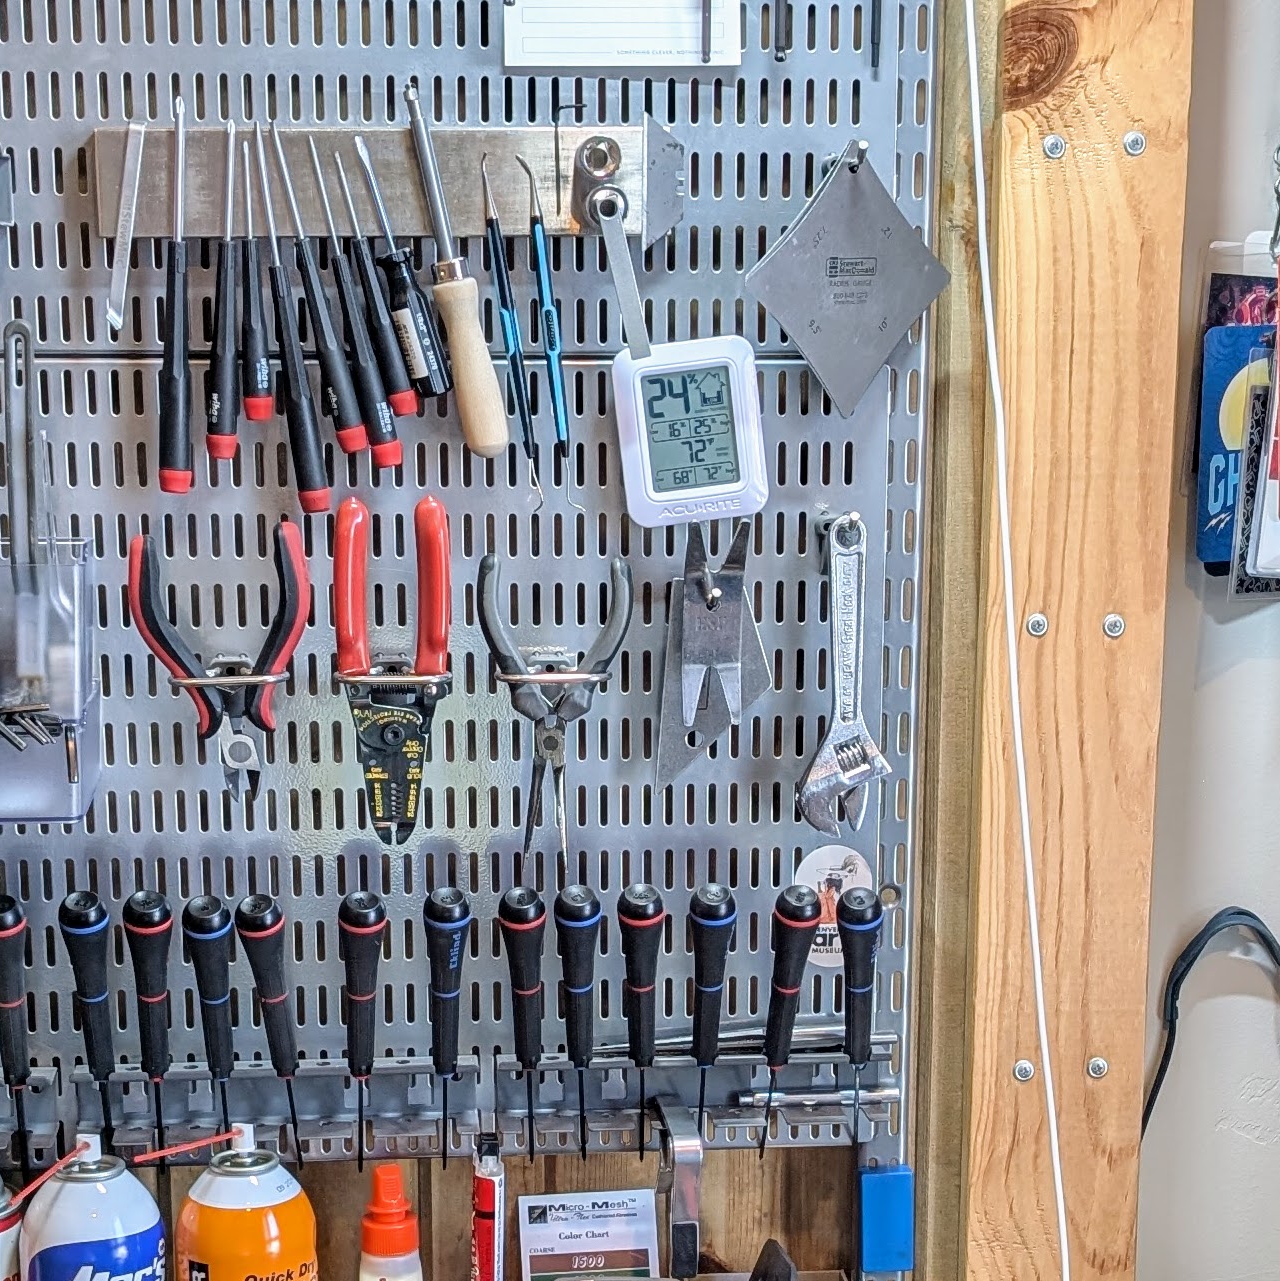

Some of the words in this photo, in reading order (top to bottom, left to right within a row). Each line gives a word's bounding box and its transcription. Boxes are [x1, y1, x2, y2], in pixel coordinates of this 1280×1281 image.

[558, 1231, 583, 1241] Color
[585, 1230, 610, 1240] Chart
[529, 1246, 556, 1254] COARSE
[571, 1255, 605, 1269] 1500
